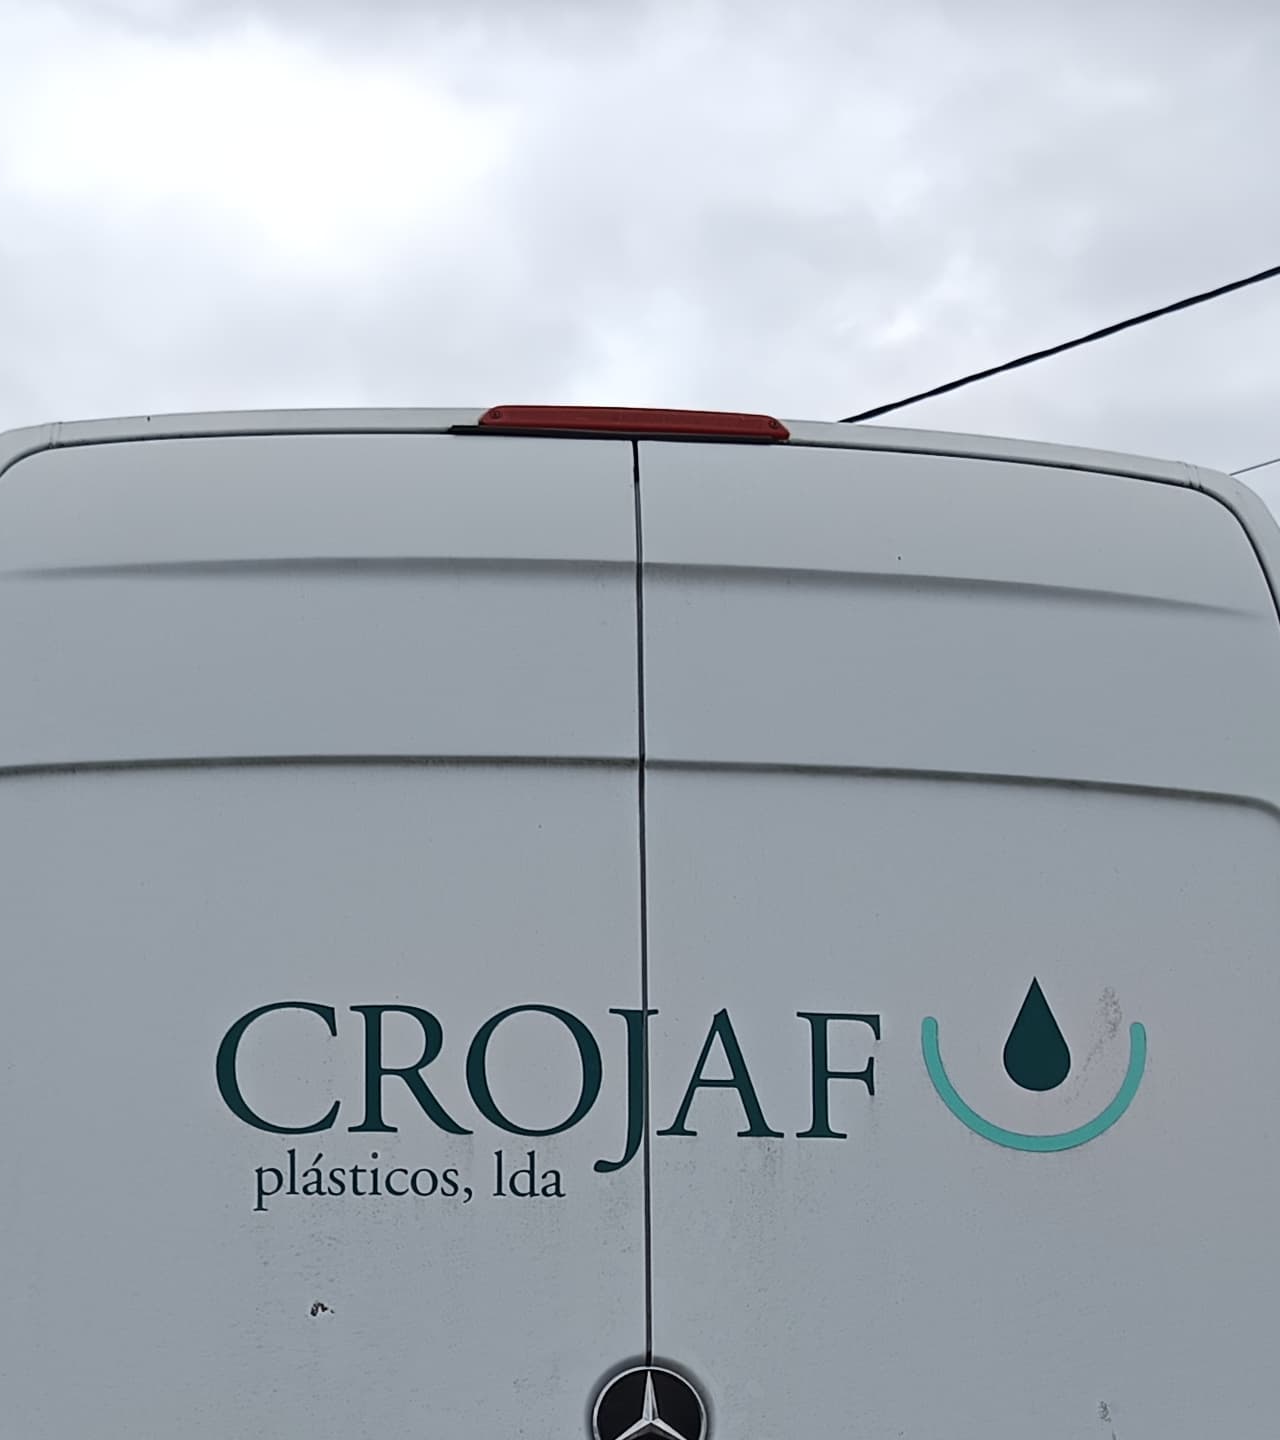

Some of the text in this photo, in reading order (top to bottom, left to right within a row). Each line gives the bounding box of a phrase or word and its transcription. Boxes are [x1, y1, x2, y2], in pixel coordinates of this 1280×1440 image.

[214, 1001, 882, 1174] CROJAF
[253, 1150, 566, 1211] plásticos, lda
